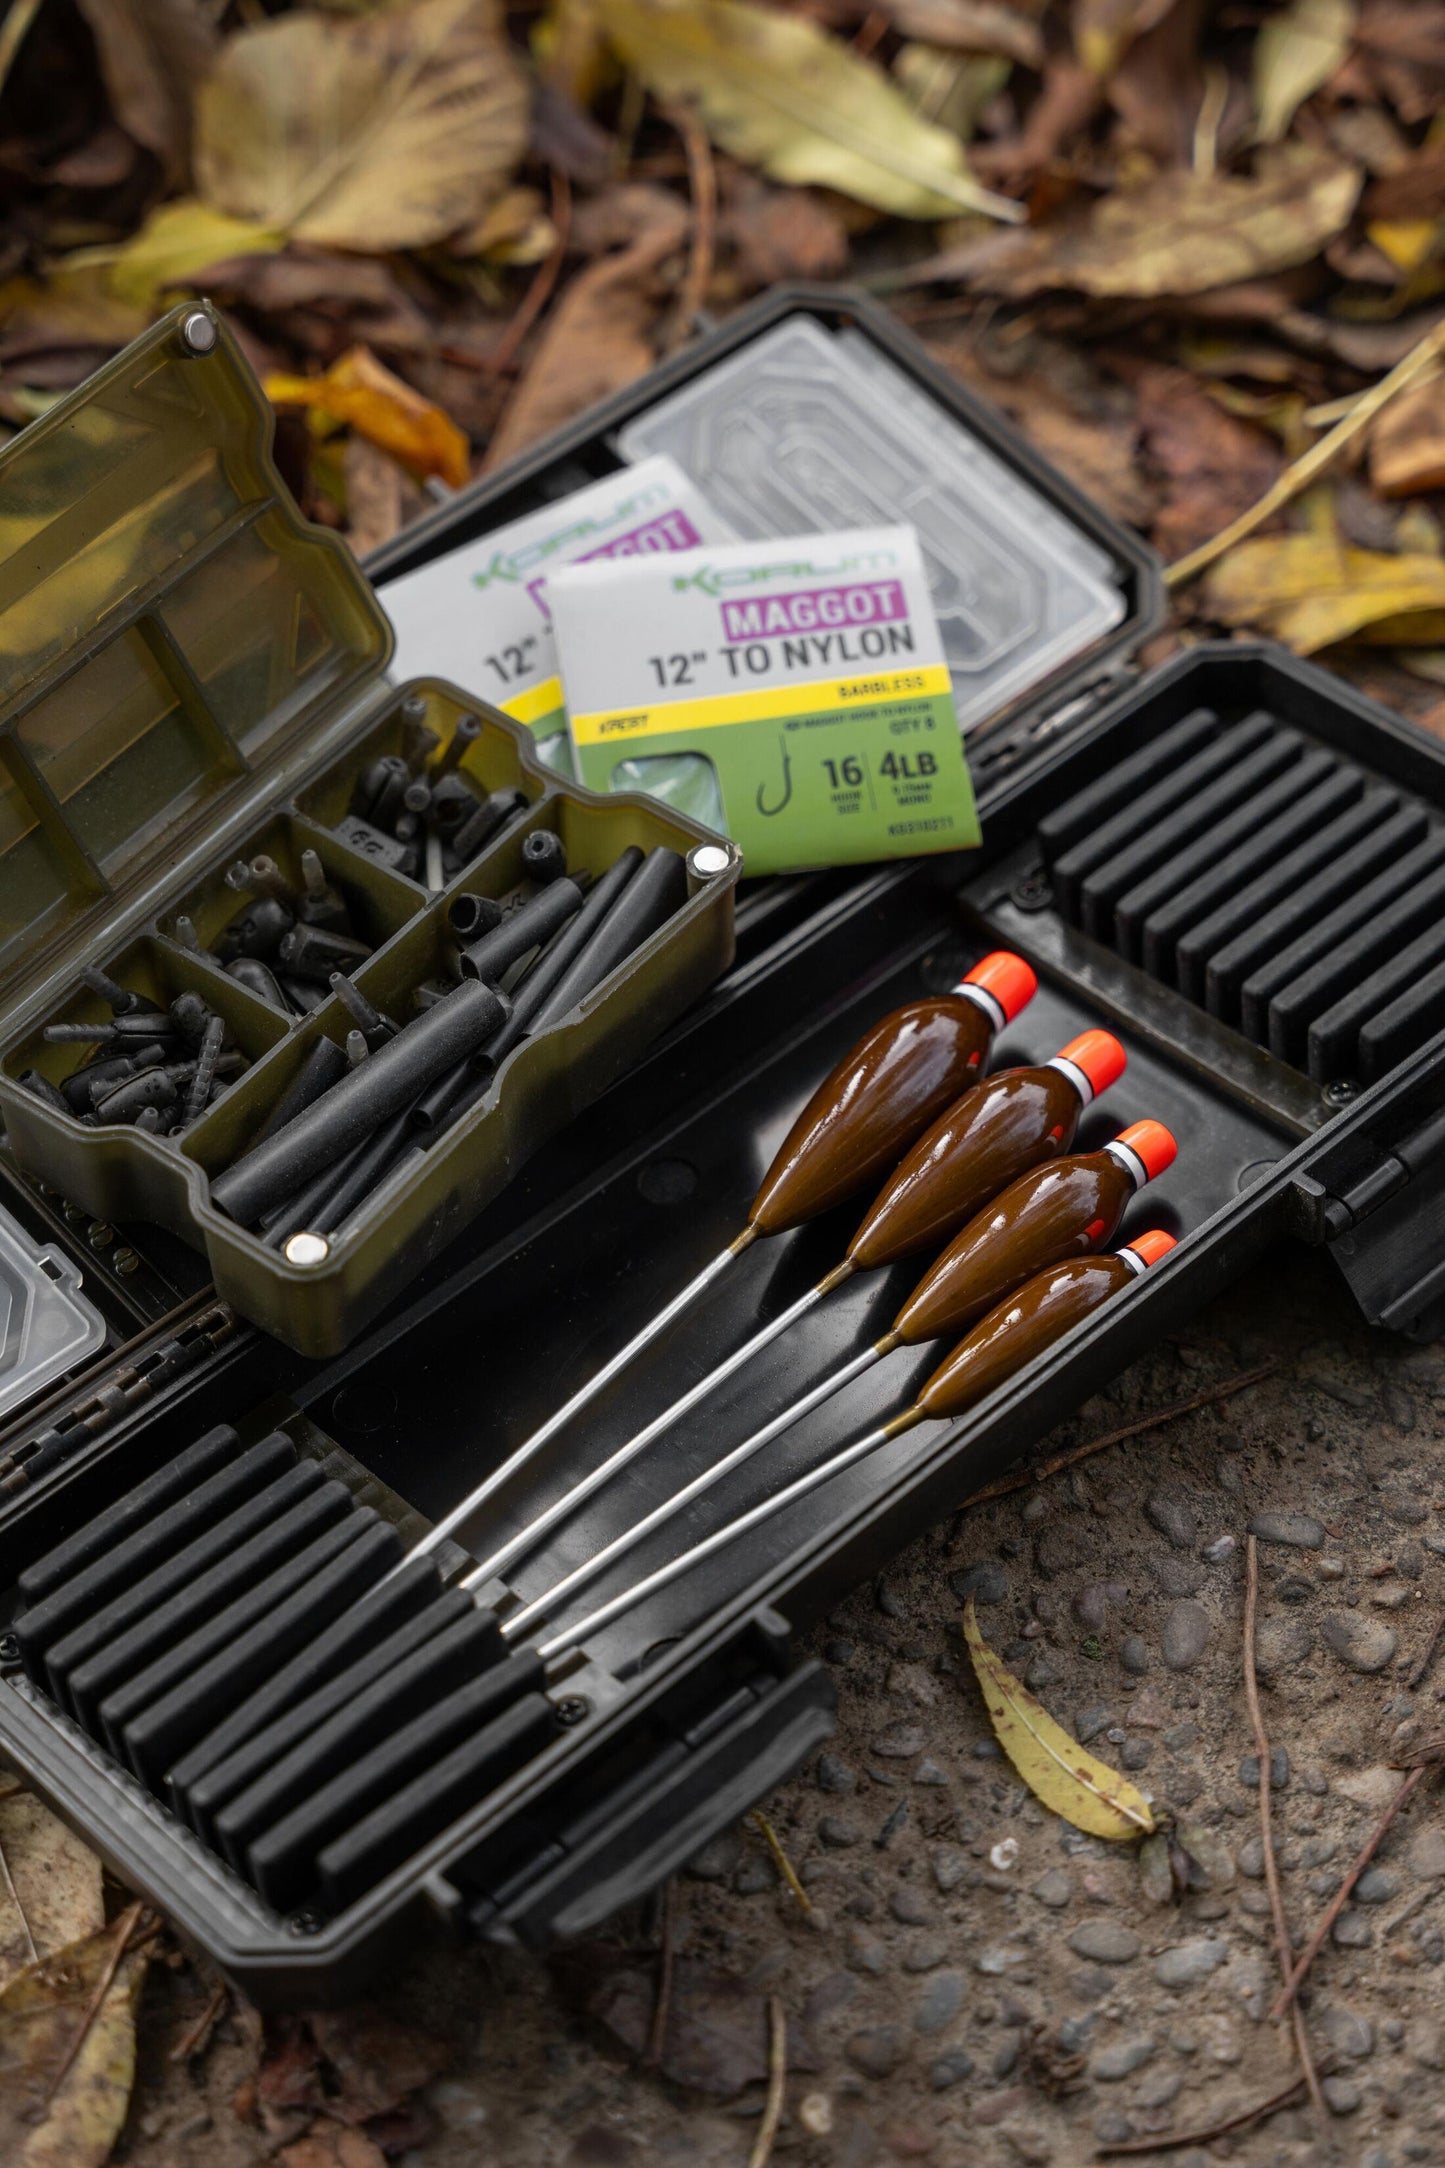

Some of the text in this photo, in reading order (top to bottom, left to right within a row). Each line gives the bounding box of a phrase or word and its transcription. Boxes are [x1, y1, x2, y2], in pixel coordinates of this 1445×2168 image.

[725, 584, 897, 637] MAGGOT
[648, 624, 916, 687] 12" TO NYLON
[838, 676, 925, 697] BARBLESS
[821, 754, 864, 790] 16
[878, 750, 939, 781] 4LB
